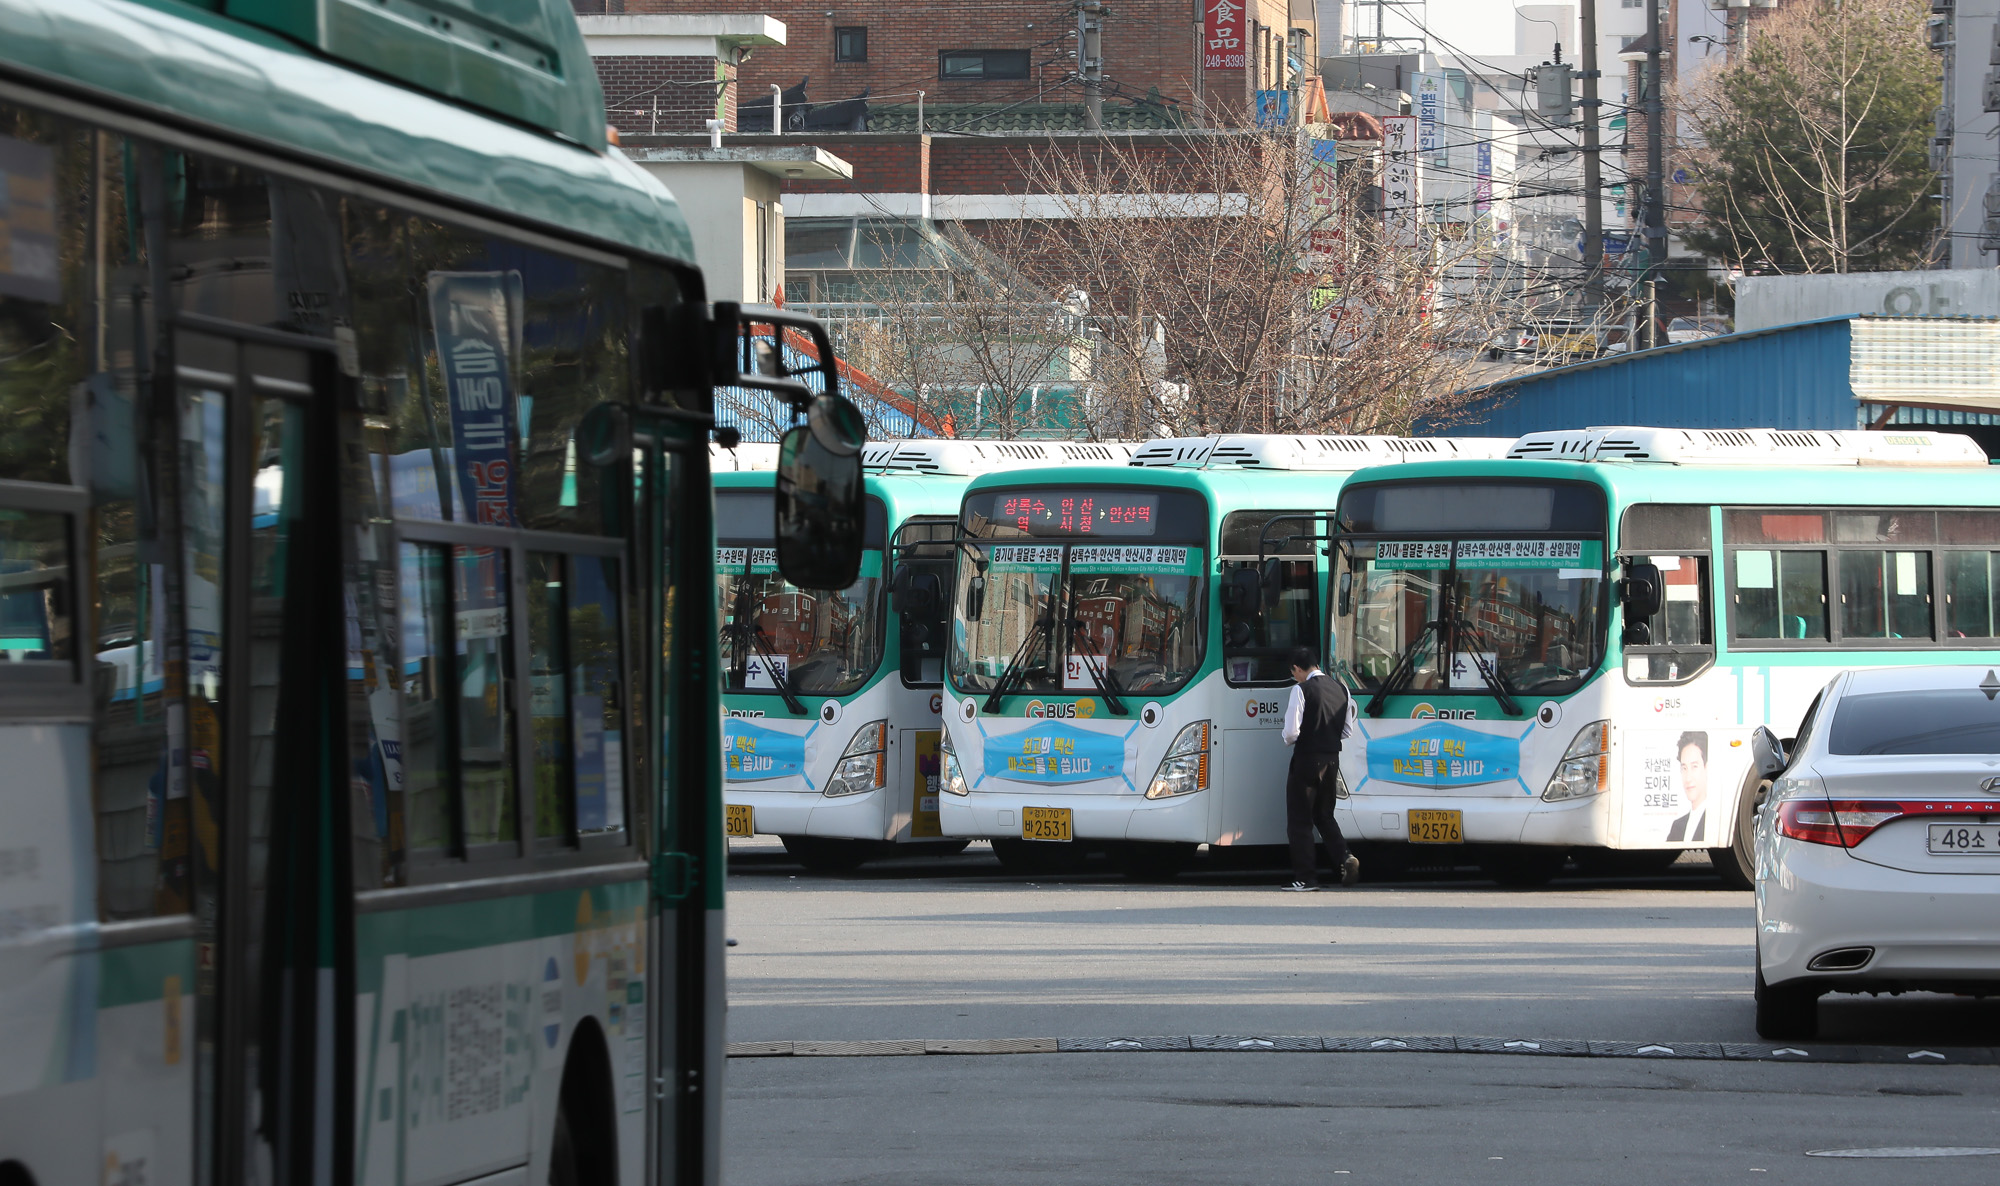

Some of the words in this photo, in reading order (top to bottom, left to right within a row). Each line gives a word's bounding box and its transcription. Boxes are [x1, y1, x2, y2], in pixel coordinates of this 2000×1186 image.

[1205, 54, 1245, 68] 248-8393
[1003, 498, 1045, 515] 상록수
[1109, 506, 1151, 523] 안산역
[1017, 516, 1029, 532] 역
[724, 549, 744, 563] 수원역
[752, 549, 777, 563] 상록수역
[994, 547, 1014, 562] 경기대
[1016, 547, 1036, 562] 팔달문
[1039, 547, 1060, 562] 수원역
[1071, 547, 1097, 563] 상록수역
[1099, 547, 1121, 562] 안산역
[1125, 547, 1153, 563] 안산시청
[1156, 548, 1186, 564] 삼일제약
[1379, 543, 1399, 558] 경기대
[1402, 543, 1423, 558] 팔달문
[1427, 543, 1448, 558] 수원역
[1457, 542, 1486, 557] 상록수역
[1488, 542, 1511, 557] 안산역
[1516, 541, 1546, 557] 안산시청
[1550, 541, 1580, 557] 삼일제약
[1367, 657, 1392, 676] 11
[1730, 667, 1771, 725] 11
[736, 735, 758, 754] 백신
[1023, 737, 1052, 755] 최고의
[1054, 738, 1076, 755] 백신
[1408, 738, 1441, 757] 최고의
[1443, 740, 1466, 757] 백신
[729, 755, 740, 772] 꼭
[742, 755, 774, 772] 씁시다
[1008, 757, 1046, 775] 마스크를
[1047, 757, 1058, 775] 꼭
[1060, 757, 1092, 775] 씁시다
[1393, 759, 1434, 778] 마스크를
[1435, 760, 1448, 778] 꼭
[1450, 760, 1485, 778] 씁시다
[1644, 758, 1671, 773] 차살땐
[1644, 775, 1671, 791] 도이치
[1643, 793, 1679, 808] 오토월드
[729, 806, 740, 815] 70
[726, 816, 749, 834] 501
[1941, 828, 1986, 849] 48소
